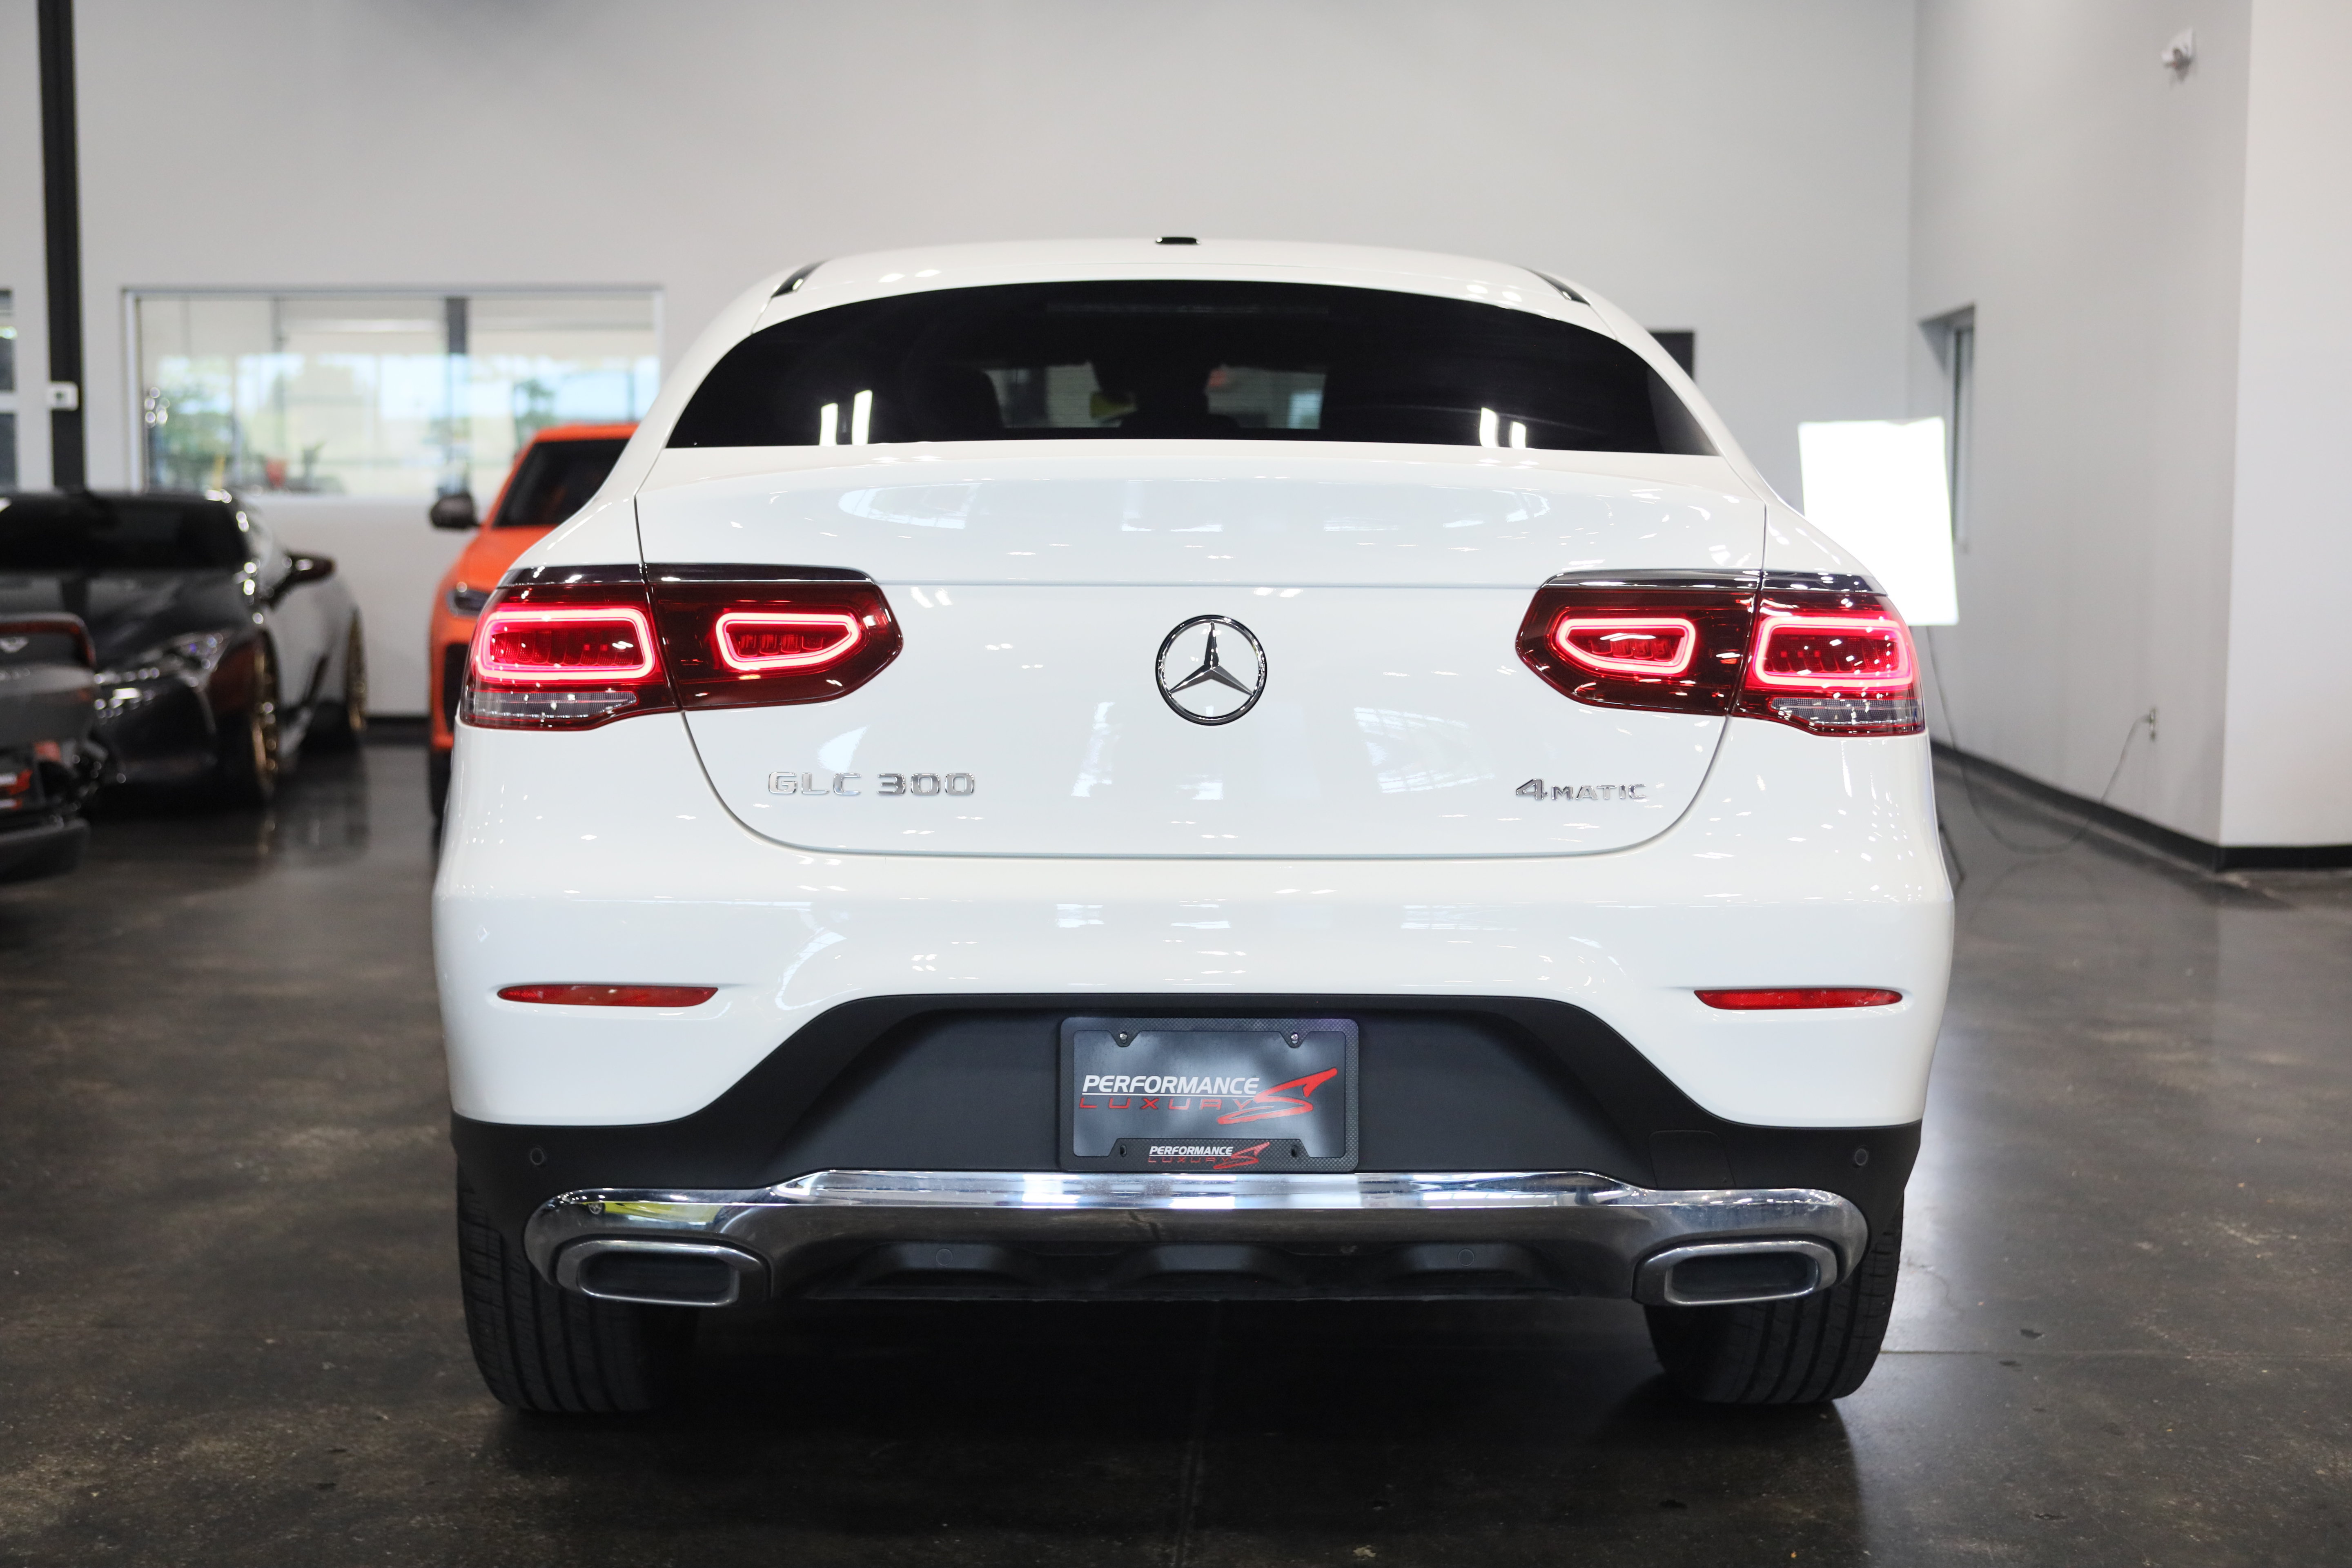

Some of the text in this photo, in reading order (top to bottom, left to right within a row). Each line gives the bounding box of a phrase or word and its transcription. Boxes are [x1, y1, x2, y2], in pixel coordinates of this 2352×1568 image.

[768, 771, 976, 796] GLC 300
[1516, 778, 1646, 800] 4MATIC
[1082, 1075, 1260, 1094] PERFORMANCE
[1079, 1097, 1254, 1110] LUXURY
[1149, 1146, 1234, 1155] PERFORMANCE
